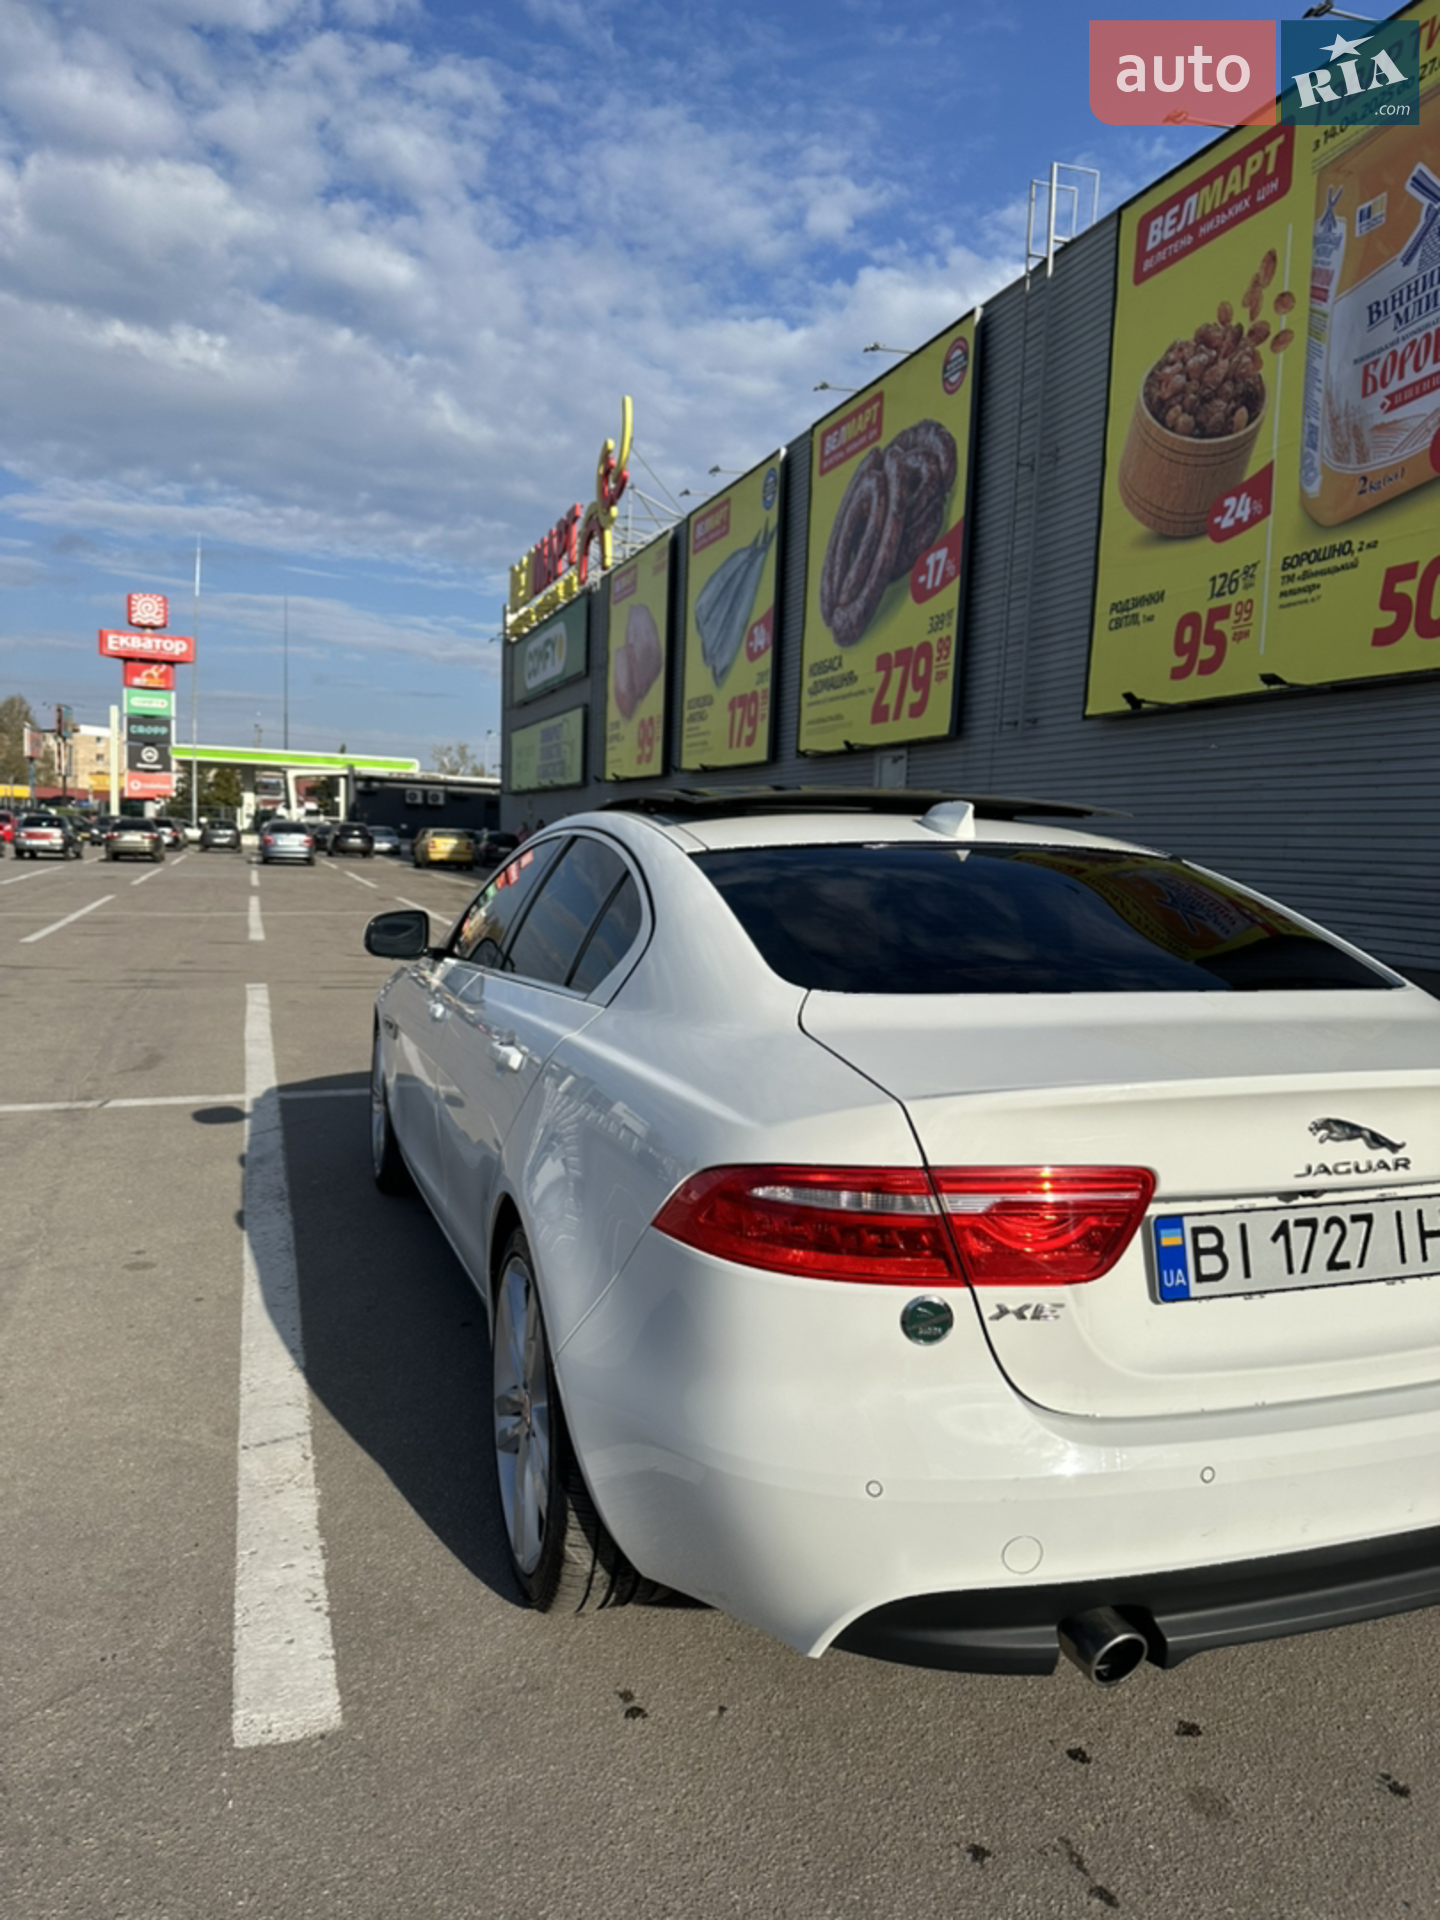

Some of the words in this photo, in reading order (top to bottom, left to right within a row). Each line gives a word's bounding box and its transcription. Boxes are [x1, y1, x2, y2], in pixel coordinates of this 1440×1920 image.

[1146, 134, 1285, 251] ВЕЛМАРТ
[1198, 196, 1252, 238] НИЗЬКИХ
[1256, 178, 1279, 202] ЦІН
[1367, 266, 1440, 328] ВІННИ
[825, 401, 880, 457] ВЕЛМАРТ
[1281, 540, 1354, 571] БОРОШНО,
[1109, 590, 1165, 615] РОДЗИНКИ
[1208, 569, 1240, 600] 126
[1233, 598, 1254, 623] 99
[935, 635, 951, 662] 99
[1170, 604, 1232, 680] 95
[870, 640, 933, 725] 279
[728, 690, 759, 750] 179
[1294, 1157, 1411, 1178] JAGUAR
[1190, 1222, 1252, 1283] BI
[1270, 1212, 1374, 1276] 1727
[1163, 1268, 1187, 1288] UA
[988, 1302, 1066, 1321] XE
